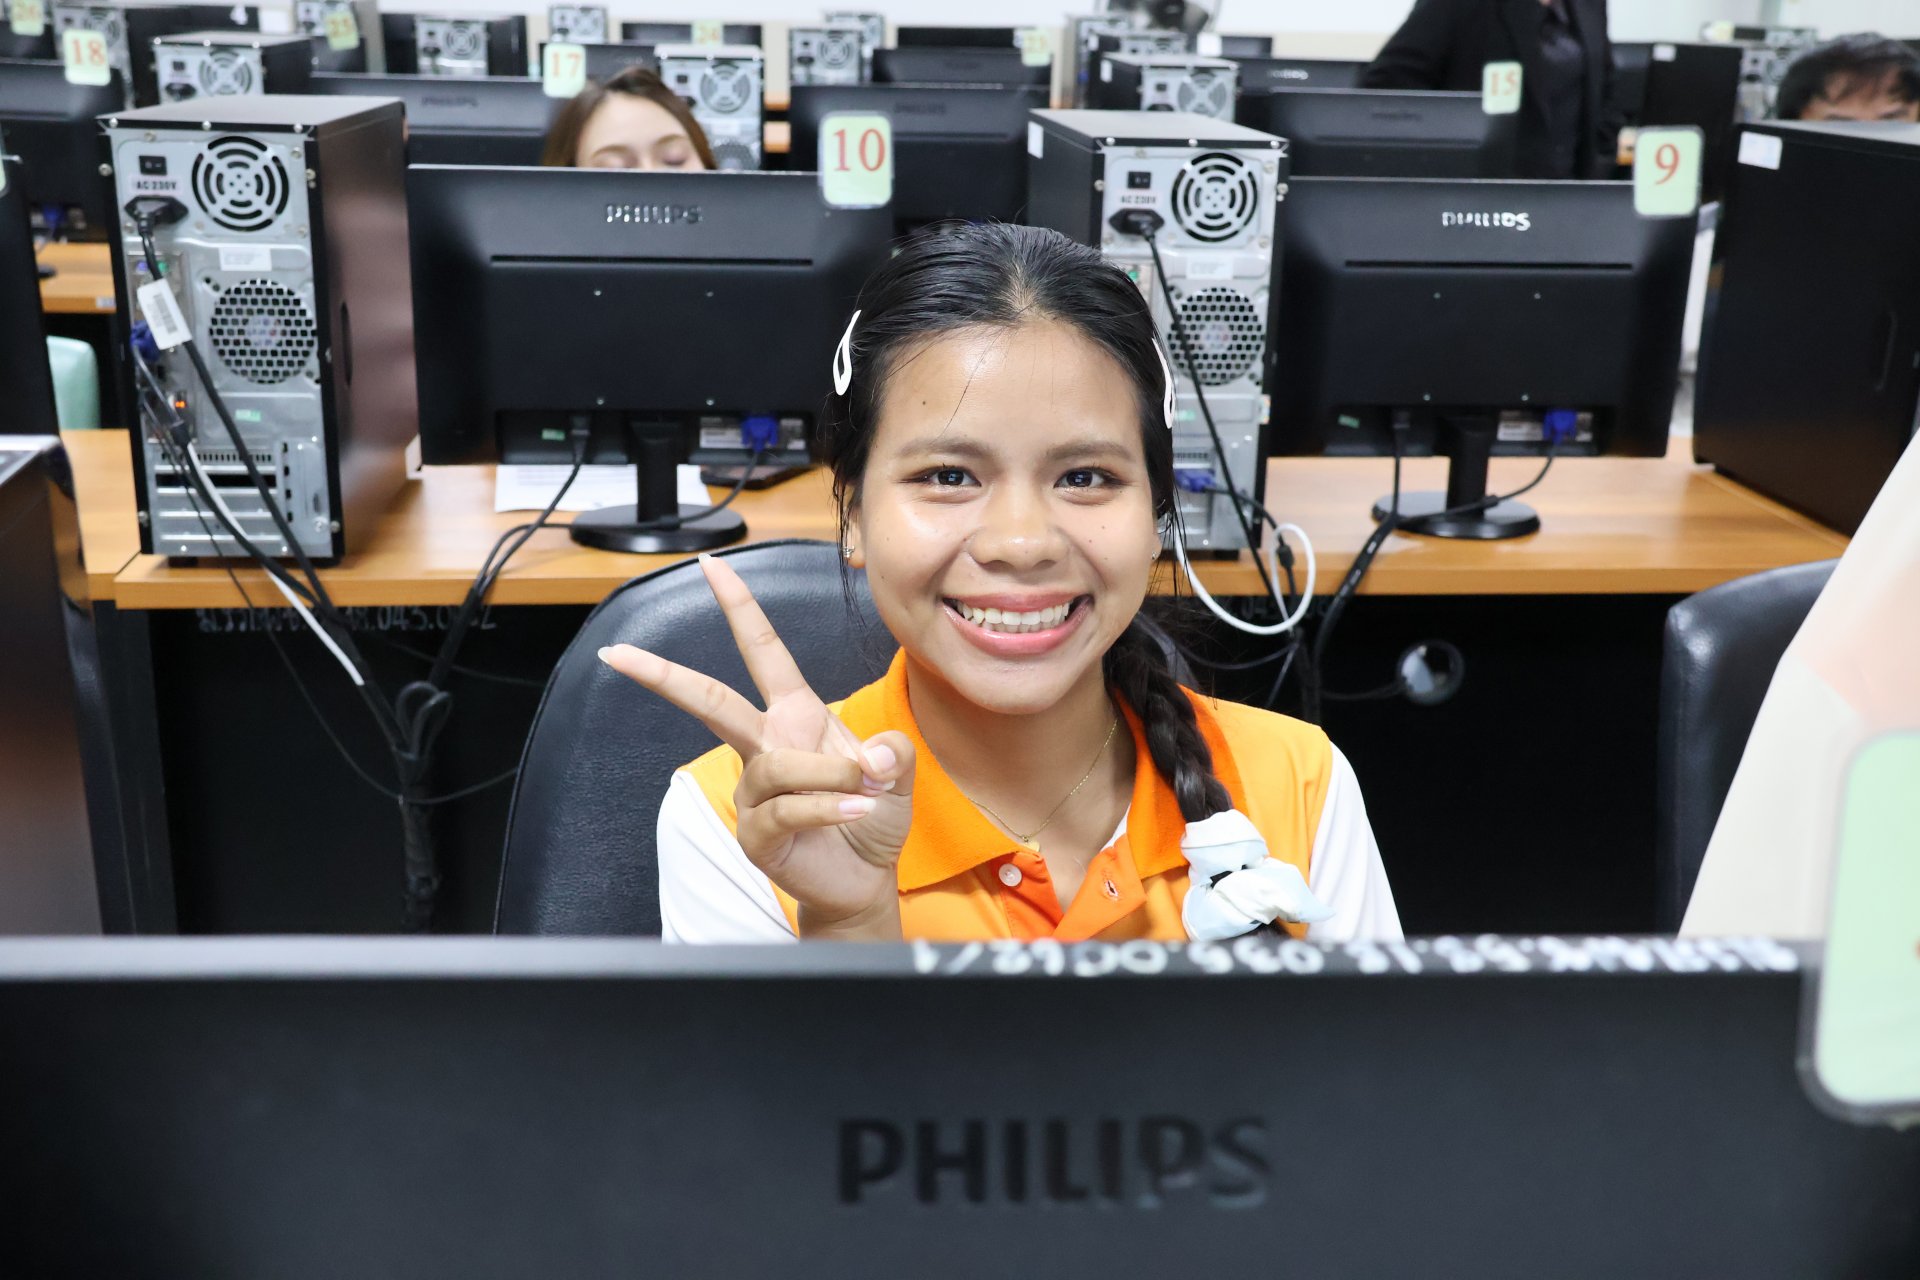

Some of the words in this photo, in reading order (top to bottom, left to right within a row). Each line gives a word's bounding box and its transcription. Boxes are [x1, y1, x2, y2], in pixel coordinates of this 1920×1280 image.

[71, 38, 105, 66] 18
[552, 52, 582, 79] 17
[1490, 70, 1518, 97] 15
[833, 128, 886, 172] 10
[1655, 143, 1680, 186] 9
[136, 181, 150, 190] AC
[152, 181, 177, 191] 230V
[604, 204, 704, 224] PHILIPS
[1441, 211, 1531, 231] PHILIPS
[838, 1115, 1273, 1208] PHILIPS
